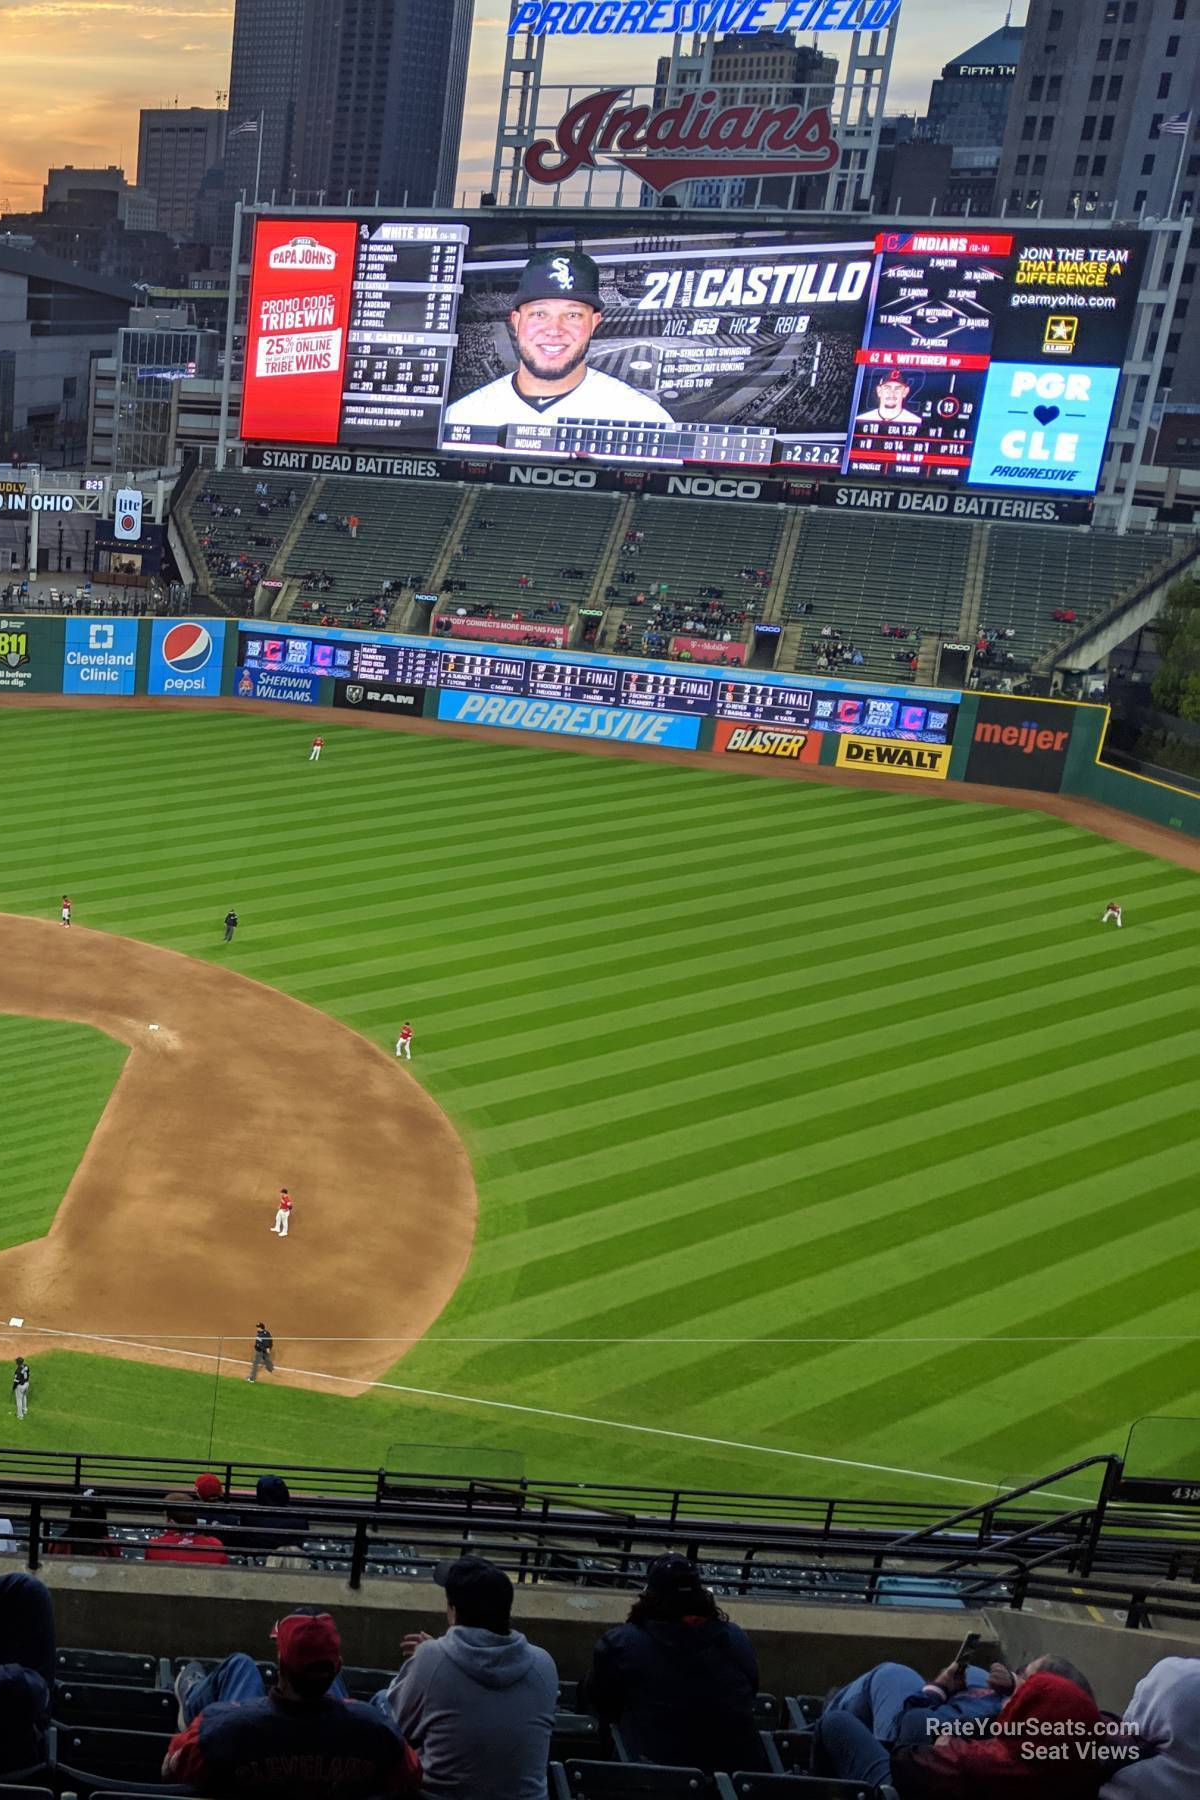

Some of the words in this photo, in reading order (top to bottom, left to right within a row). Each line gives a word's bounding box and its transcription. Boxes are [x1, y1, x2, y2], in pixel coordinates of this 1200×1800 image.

[507, 0, 771, 35] PROGRESSIVE
[775, 0, 900, 33] FIELD
[960, 66, 994, 75] FIFTH
[524, 88, 842, 185] Indians
[382, 227, 413, 239] WHITE
[417, 228, 438, 239] SOX
[912, 237, 968, 251] INDIANS
[273, 250, 297, 264] PAPA
[1020, 248, 1054, 260] JOIN
[1057, 248, 1085, 260] THE
[1089, 250, 1128, 262] TEAM
[1019, 261, 1055, 271] THAT
[1058, 261, 1107, 273] MAKES
[1111, 263, 1121, 274] A
[637, 271, 682, 309] 21
[693, 261, 871, 307] CASTILLO
[1016, 272, 1108, 286] DIFFERENCE.
[262, 298, 300, 314] PROMO
[1011, 294, 1116, 308] goarmyohio.com
[260, 305, 335, 331] TRIBEWIN
[729, 317, 747, 334] HR
[747, 316, 761, 334] 2
[774, 316, 797, 334] RBI
[796, 315, 811, 333] 8
[662, 319, 687, 336] AVG
[687, 318, 720, 334] .159
[266, 338, 284, 356] 25
[296, 339, 332, 353] ONLINE
[265, 361, 293, 374] TRIBE
[296, 353, 331, 371] WINS
[870, 353, 879, 362] 62
[897, 354, 947, 366] WITTGREN
[1010, 371, 1092, 401] PGR
[944, 403, 954, 412] 13
[517, 426, 538, 436] WHITE
[539, 427, 552, 436] SOX
[515, 439, 541, 448] INDIANS
[1001, 430, 1079, 462] CLE
[793, 445, 802, 461] 2
[811, 446, 820, 463] 2
[830, 447, 839, 464] 2
[262, 451, 309, 469] START
[312, 455, 352, 472] DEAD
[355, 458, 441, 478] BATTERIES.
[508, 466, 599, 488] NOCO
[990, 466, 1080, 482] PROGRESSIVE
[667, 476, 762, 499] NOCO
[7, 493, 26, 510] IN
[30, 495, 73, 512] OHIO
[119, 499, 140, 513] Lite
[835, 488, 894, 508] START
[897, 493, 948, 513] DEAD
[952, 496, 1060, 521] BATTERIES.
[579, 608, 603, 616] NOCO
[440, 617, 465, 625] NOODY
[466, 620, 500, 628] CONNECTS
[755, 625, 781, 633] NOCO
[943, 642, 970, 651] NOCO
[66, 651, 134, 666] Cleveland
[79, 668, 119, 682] Clinic
[495, 662, 522, 677] FINAL
[11, 679, 26, 687] dig.
[164, 677, 206, 691] pepsi
[258, 672, 312, 689] SHERWIN
[586, 671, 614, 686] FINAL
[680, 681, 709, 696] FINAL
[367, 691, 415, 705] RAM
[778, 692, 809, 708] FINAL
[869, 702, 893, 712] FOX
[456, 695, 674, 743] PROGRESSIVE
[868, 716, 891, 726] GO
[726, 728, 805, 759] BLASTER
[975, 720, 1070, 753] meijer
